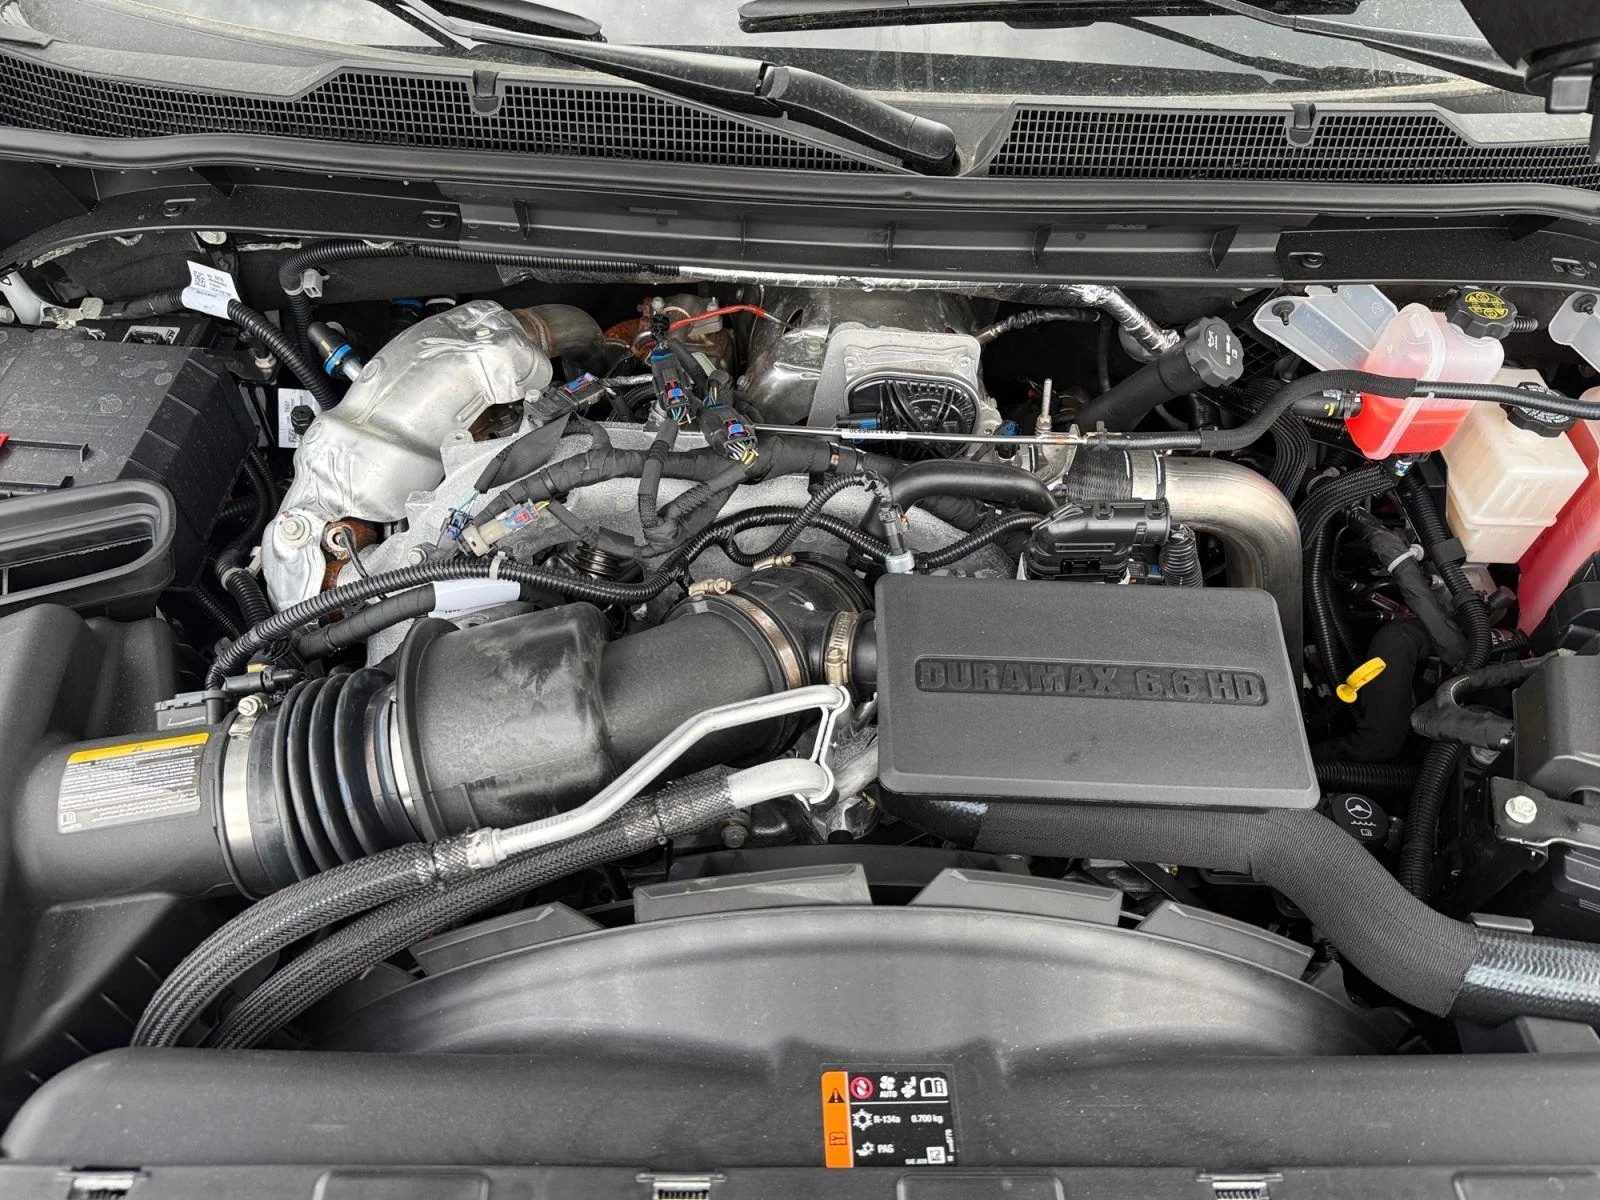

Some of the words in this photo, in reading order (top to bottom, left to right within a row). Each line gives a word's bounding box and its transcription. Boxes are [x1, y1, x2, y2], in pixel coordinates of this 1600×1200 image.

[922, 662, 1121, 694] DURAMAX
[1135, 669, 1200, 699] 6.6
[1207, 671, 1265, 702] HD
[873, 1115, 901, 1124] R-134a
[910, 1114, 932, 1124] 0.700
[932, 1114, 944, 1124] kg
[877, 1144, 895, 1154] PAG
